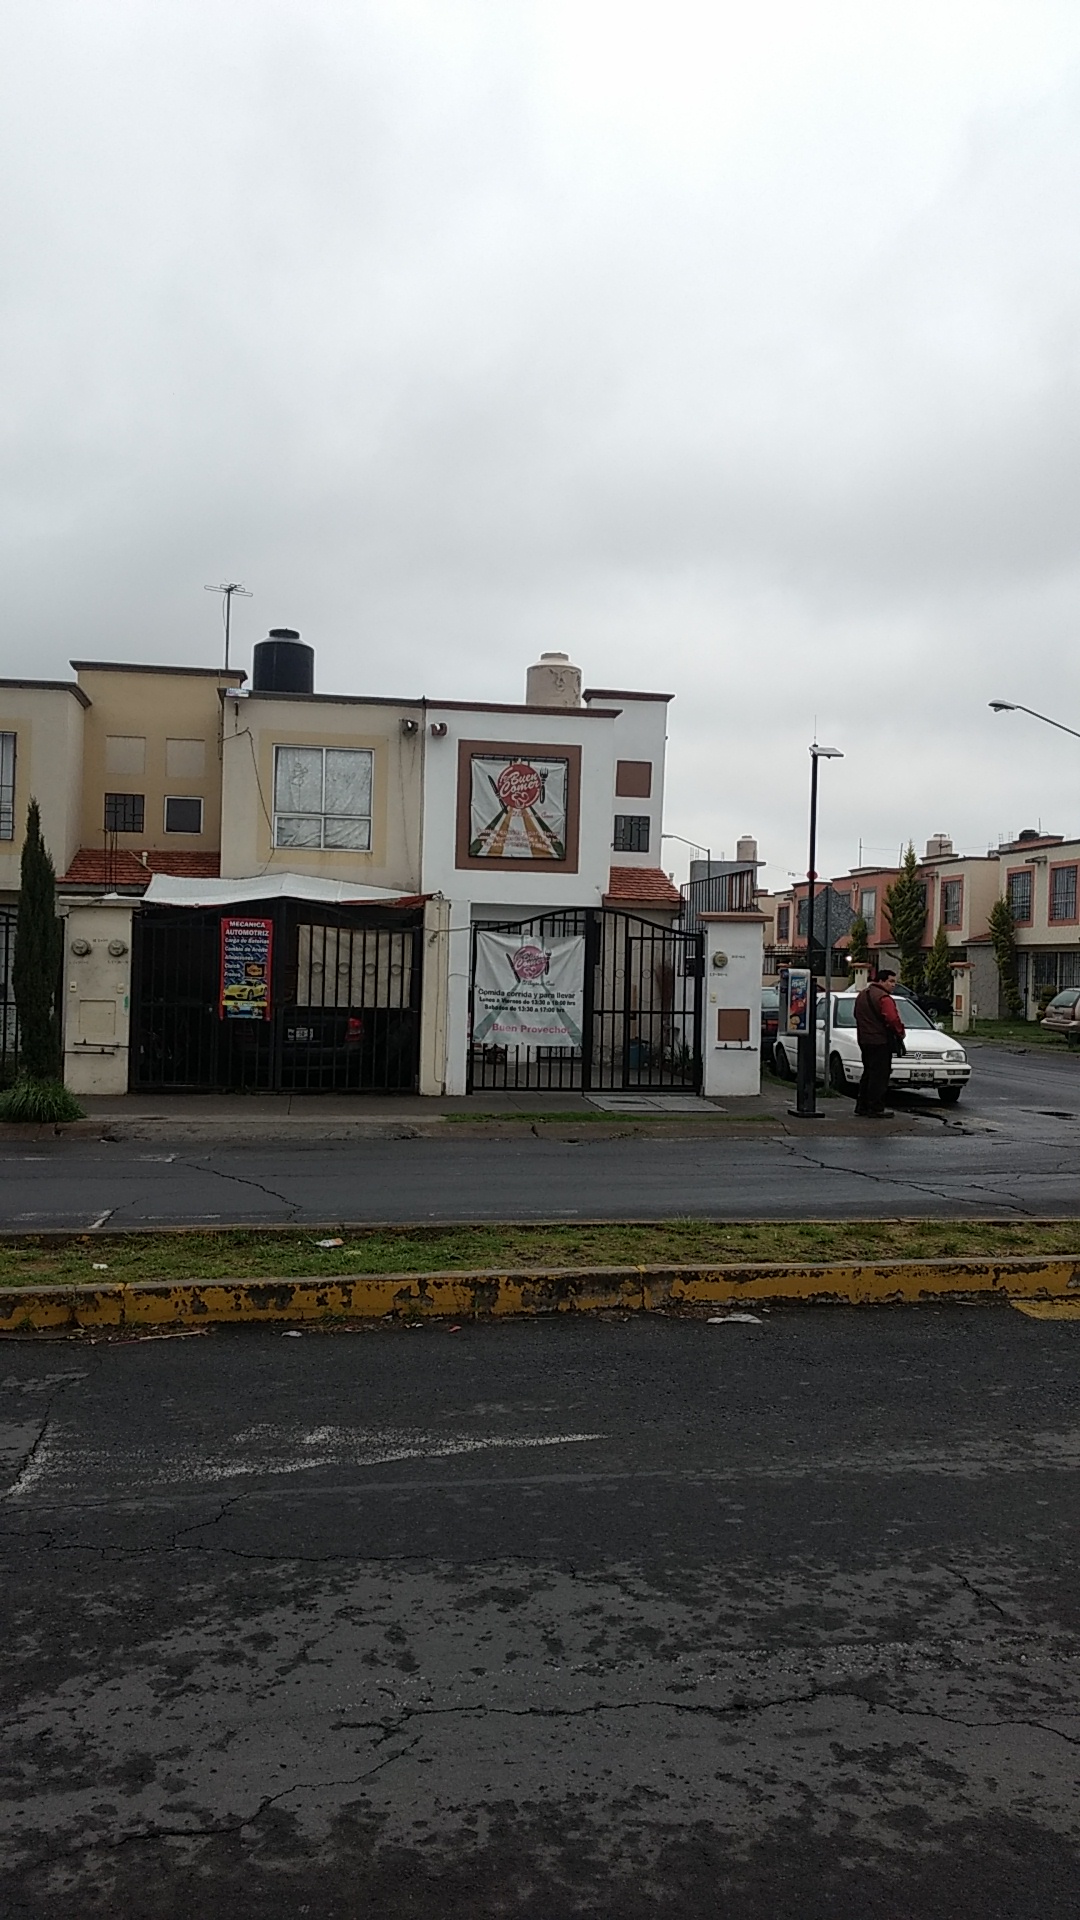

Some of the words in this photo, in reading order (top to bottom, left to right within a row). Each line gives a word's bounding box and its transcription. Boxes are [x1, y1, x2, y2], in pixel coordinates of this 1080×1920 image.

[510, 771, 538, 785] Buen
[500, 780, 540, 798] Comer
[225, 929, 270, 937] AUTOMOTRIZ
[478, 988, 505, 997] Comida
[492, 1023, 518, 1032] Buen
